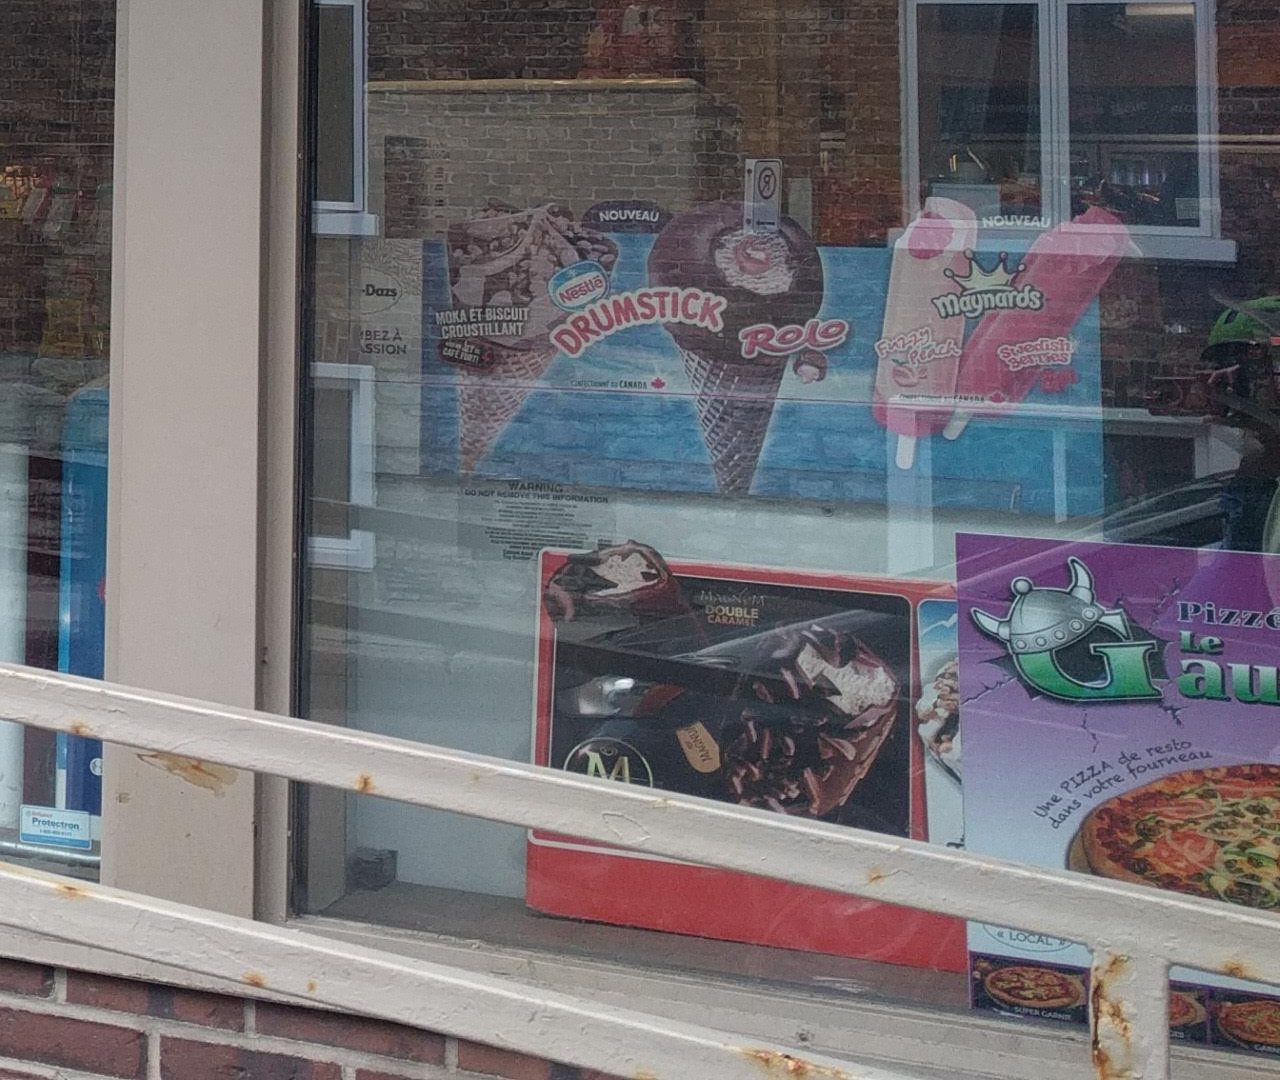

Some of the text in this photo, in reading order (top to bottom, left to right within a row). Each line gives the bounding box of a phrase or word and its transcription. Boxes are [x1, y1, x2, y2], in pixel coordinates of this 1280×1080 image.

[600, 209, 659, 223] NOUVEAU
[983, 215, 1051, 228] NOUVEAU
[362, 283, 398, 298] -Dazs
[558, 275, 604, 304] Nestlé
[435, 307, 530, 325] MOKA ET BISCUIT
[553, 291, 724, 355] DRUMSTICK
[360, 328, 403, 341] BEZ À
[441, 322, 524, 339] CROUSTILLANT
[876, 327, 931, 357] Fuzzy
[999, 337, 1074, 359] Swedish
[908, 340, 962, 367] Peach
[1008, 351, 1070, 370] Berries
[619, 379, 648, 390] CANADA
[508, 481, 564, 494] WARNING
[465, 489, 609, 504] DO NOT REMOVE THIS INFORMATION
[704, 604, 759, 619] DOUBLE
[707, 614, 756, 626] CARAMEL
[1179, 630, 1224, 655] Le
[1033, 738, 1192, 820] Une PIZZA de resto
[1051, 751, 1214, 830] dans votre fourneau
[31, 816, 80, 831] Protectron
[1008, 932, 1053, 947] LOCAL
[1014, 1006, 1040, 1016] SUPER
